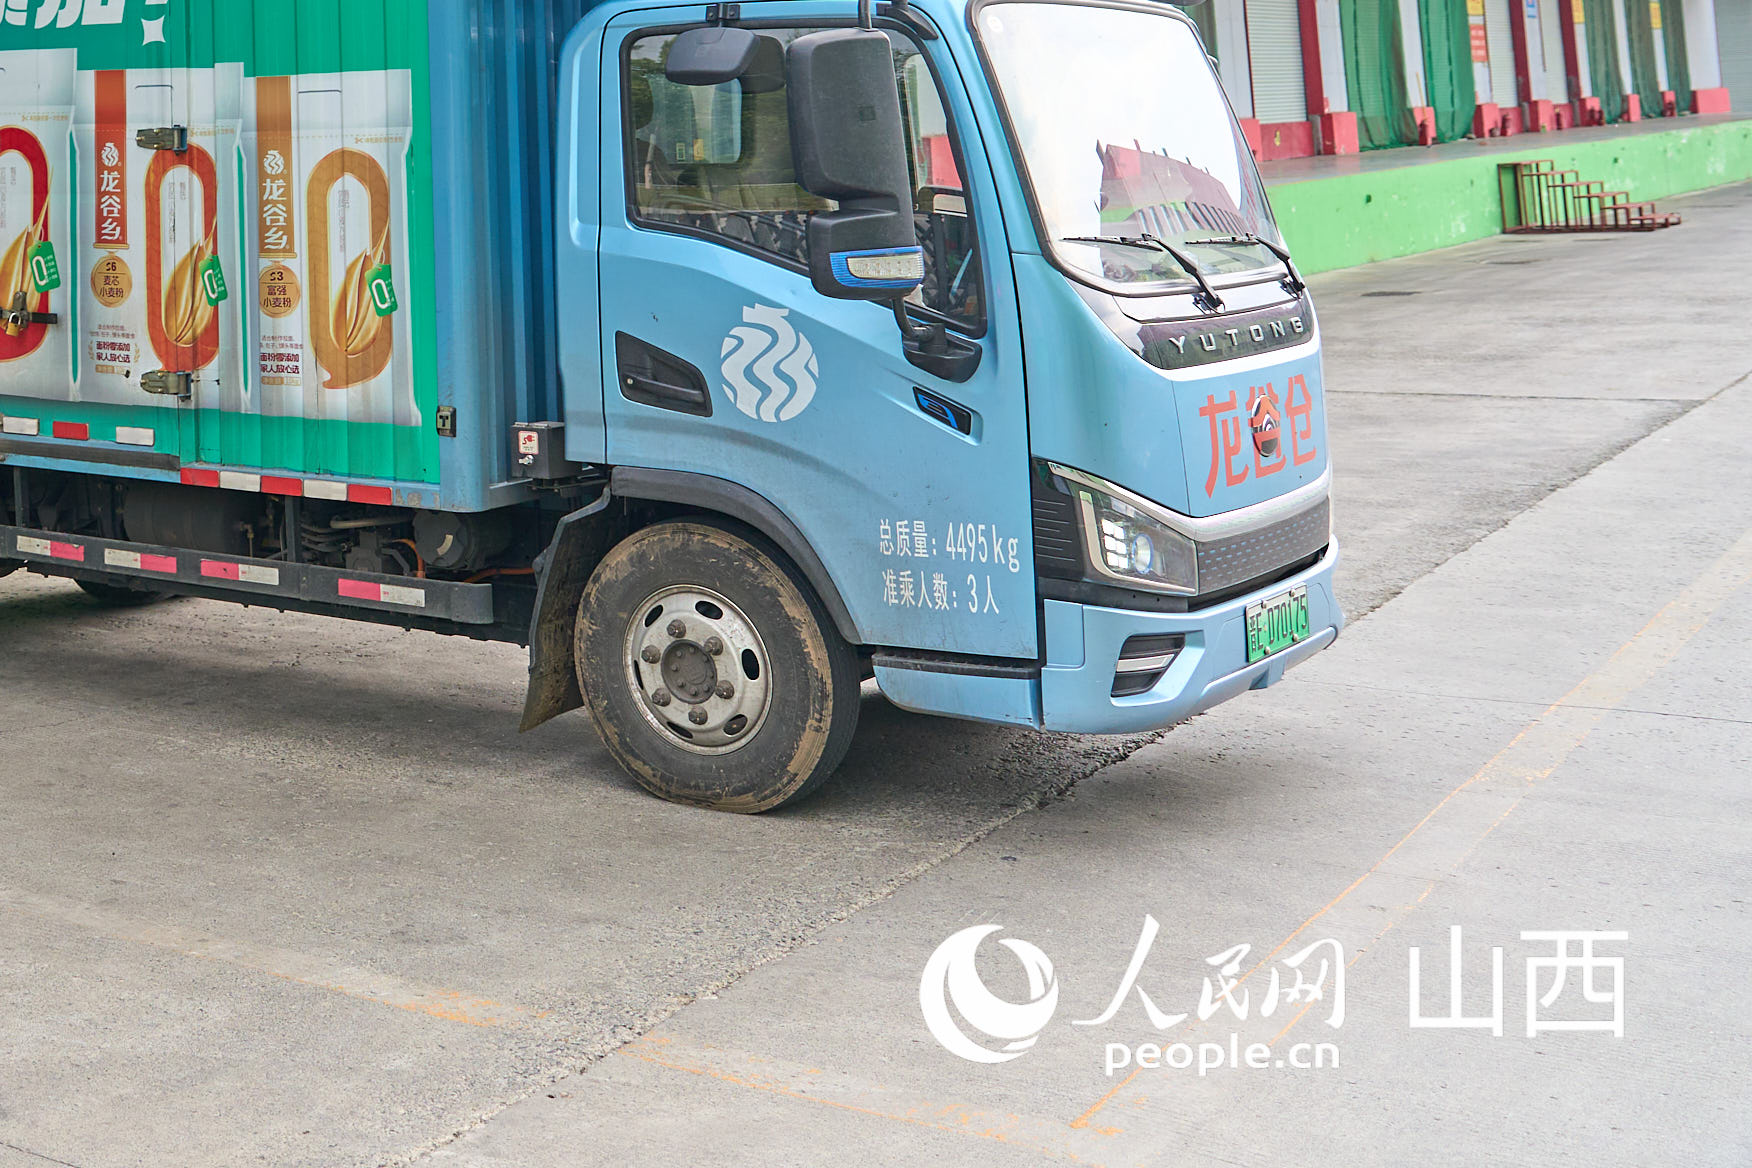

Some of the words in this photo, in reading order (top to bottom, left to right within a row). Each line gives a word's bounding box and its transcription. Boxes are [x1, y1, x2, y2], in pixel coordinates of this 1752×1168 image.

[100, 170, 121, 241] 龙谷乡
[262, 178, 289, 250] 龙谷乡
[103, 275, 120, 286] 麦芯
[99, 287, 124, 298] 小麦粉
[267, 285, 288, 296] 富强
[262, 297, 292, 308] 小麦粉
[1168, 316, 1305, 355] YUTONG
